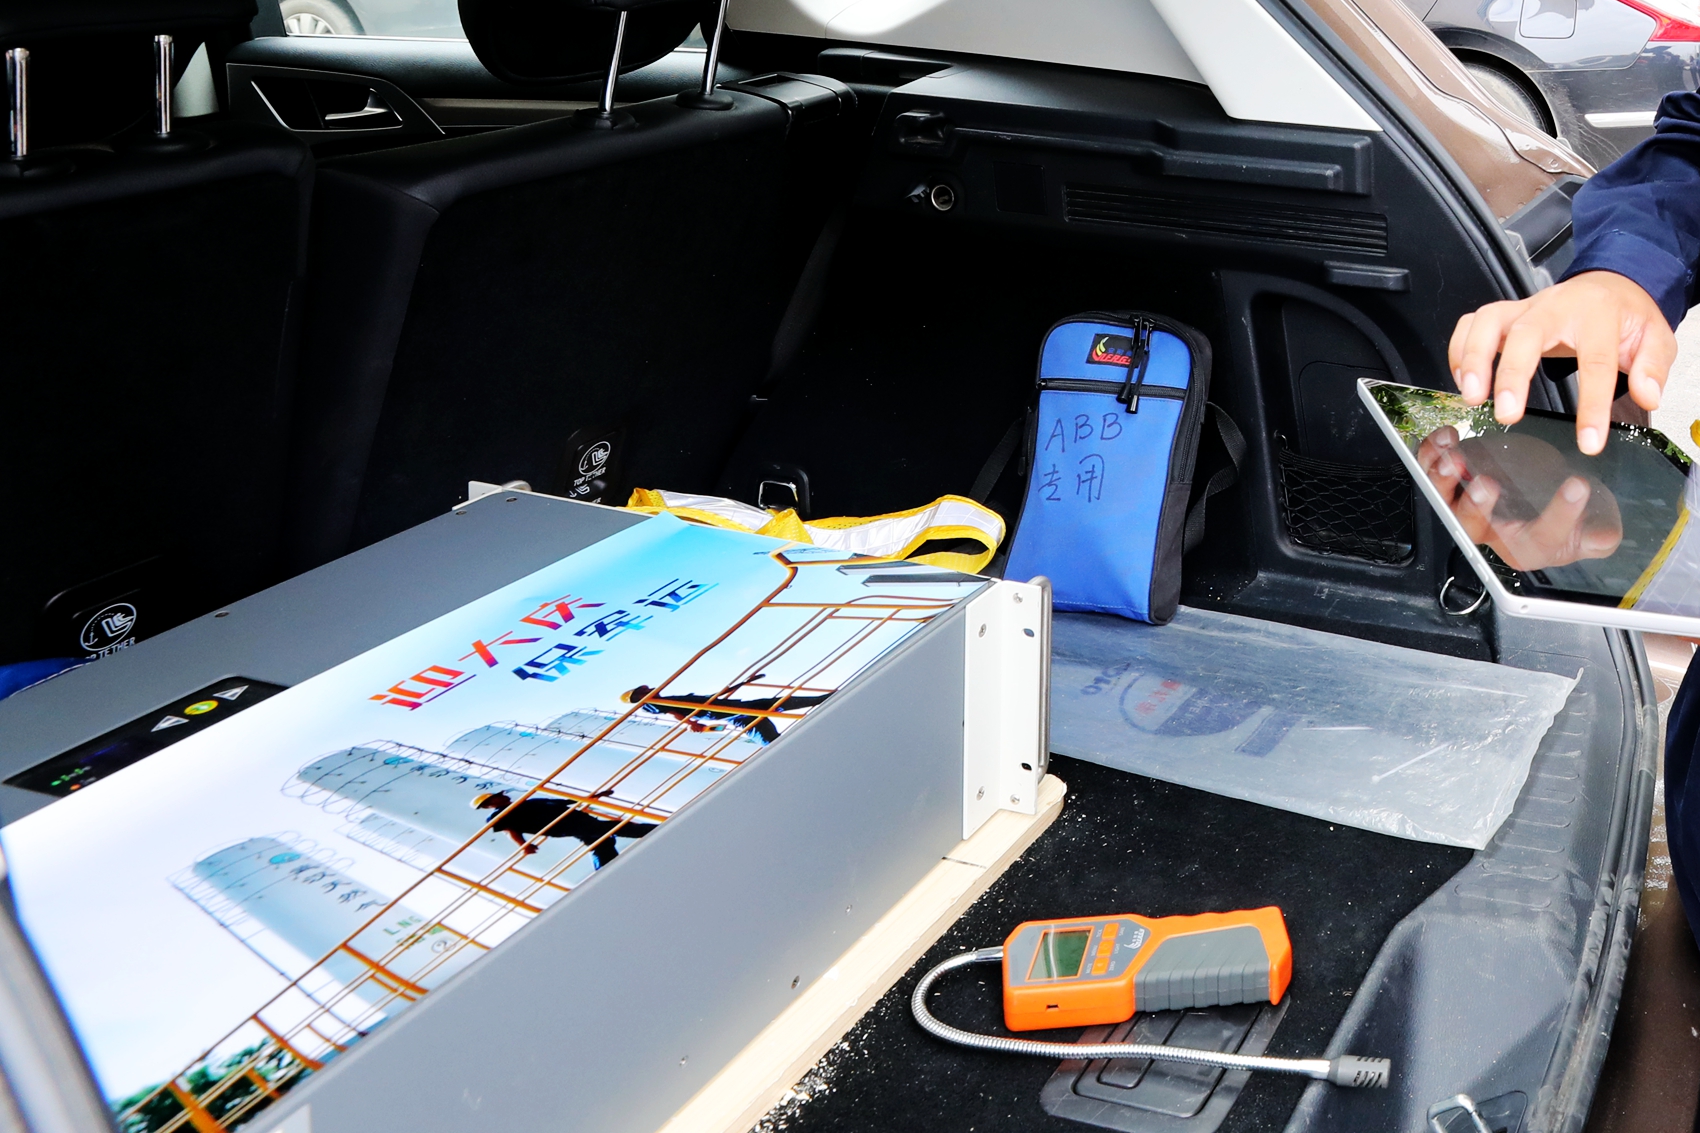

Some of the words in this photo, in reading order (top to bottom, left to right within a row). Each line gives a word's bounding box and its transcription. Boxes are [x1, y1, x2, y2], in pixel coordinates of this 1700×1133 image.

[1045, 412, 1122, 453] ABB
[574, 476, 585, 487] TOP
[1038, 453, 1105, 503] 专用
[368, 594, 607, 711] 迎大庆
[512, 578, 720, 682] 保军运
